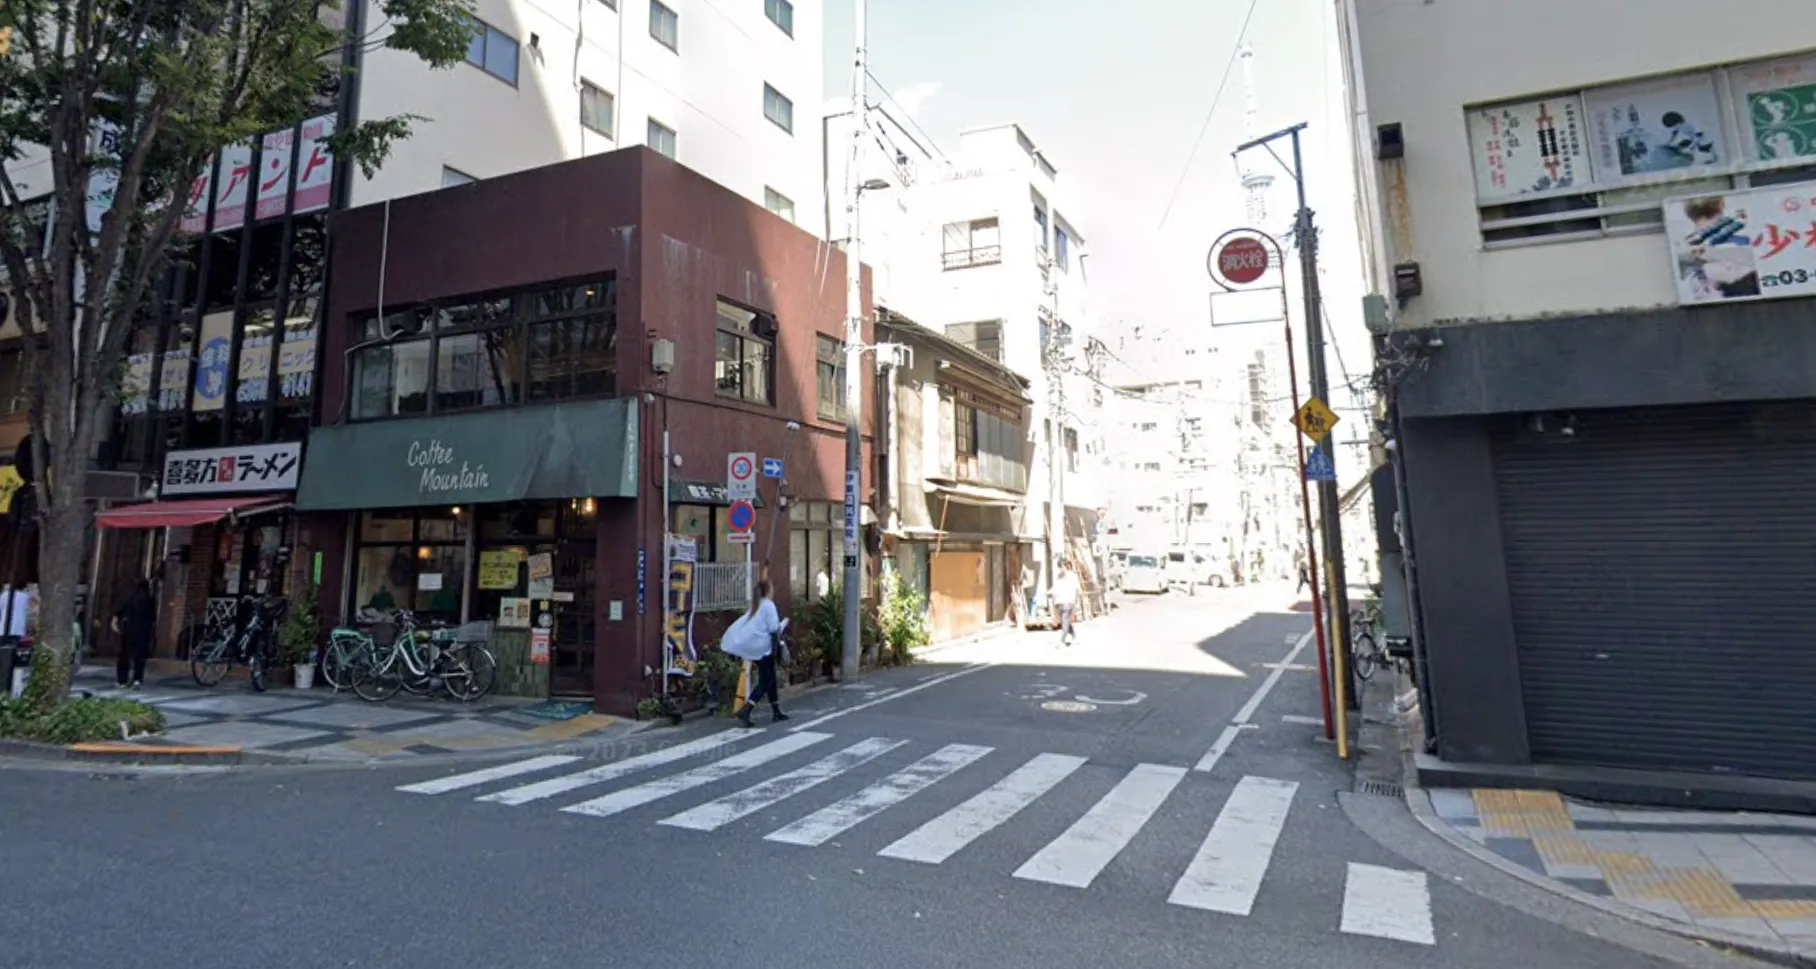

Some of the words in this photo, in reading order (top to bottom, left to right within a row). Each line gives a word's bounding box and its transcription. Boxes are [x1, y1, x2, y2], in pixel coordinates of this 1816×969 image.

[1223, 250, 1264, 271] 消火栓
[407, 439, 454, 467] Coffee
[167, 458, 217, 485] 喜多方
[237, 452, 297, 481] ラーメン
[419, 461, 490, 493] Mountain
[735, 461, 748, 475] 30
